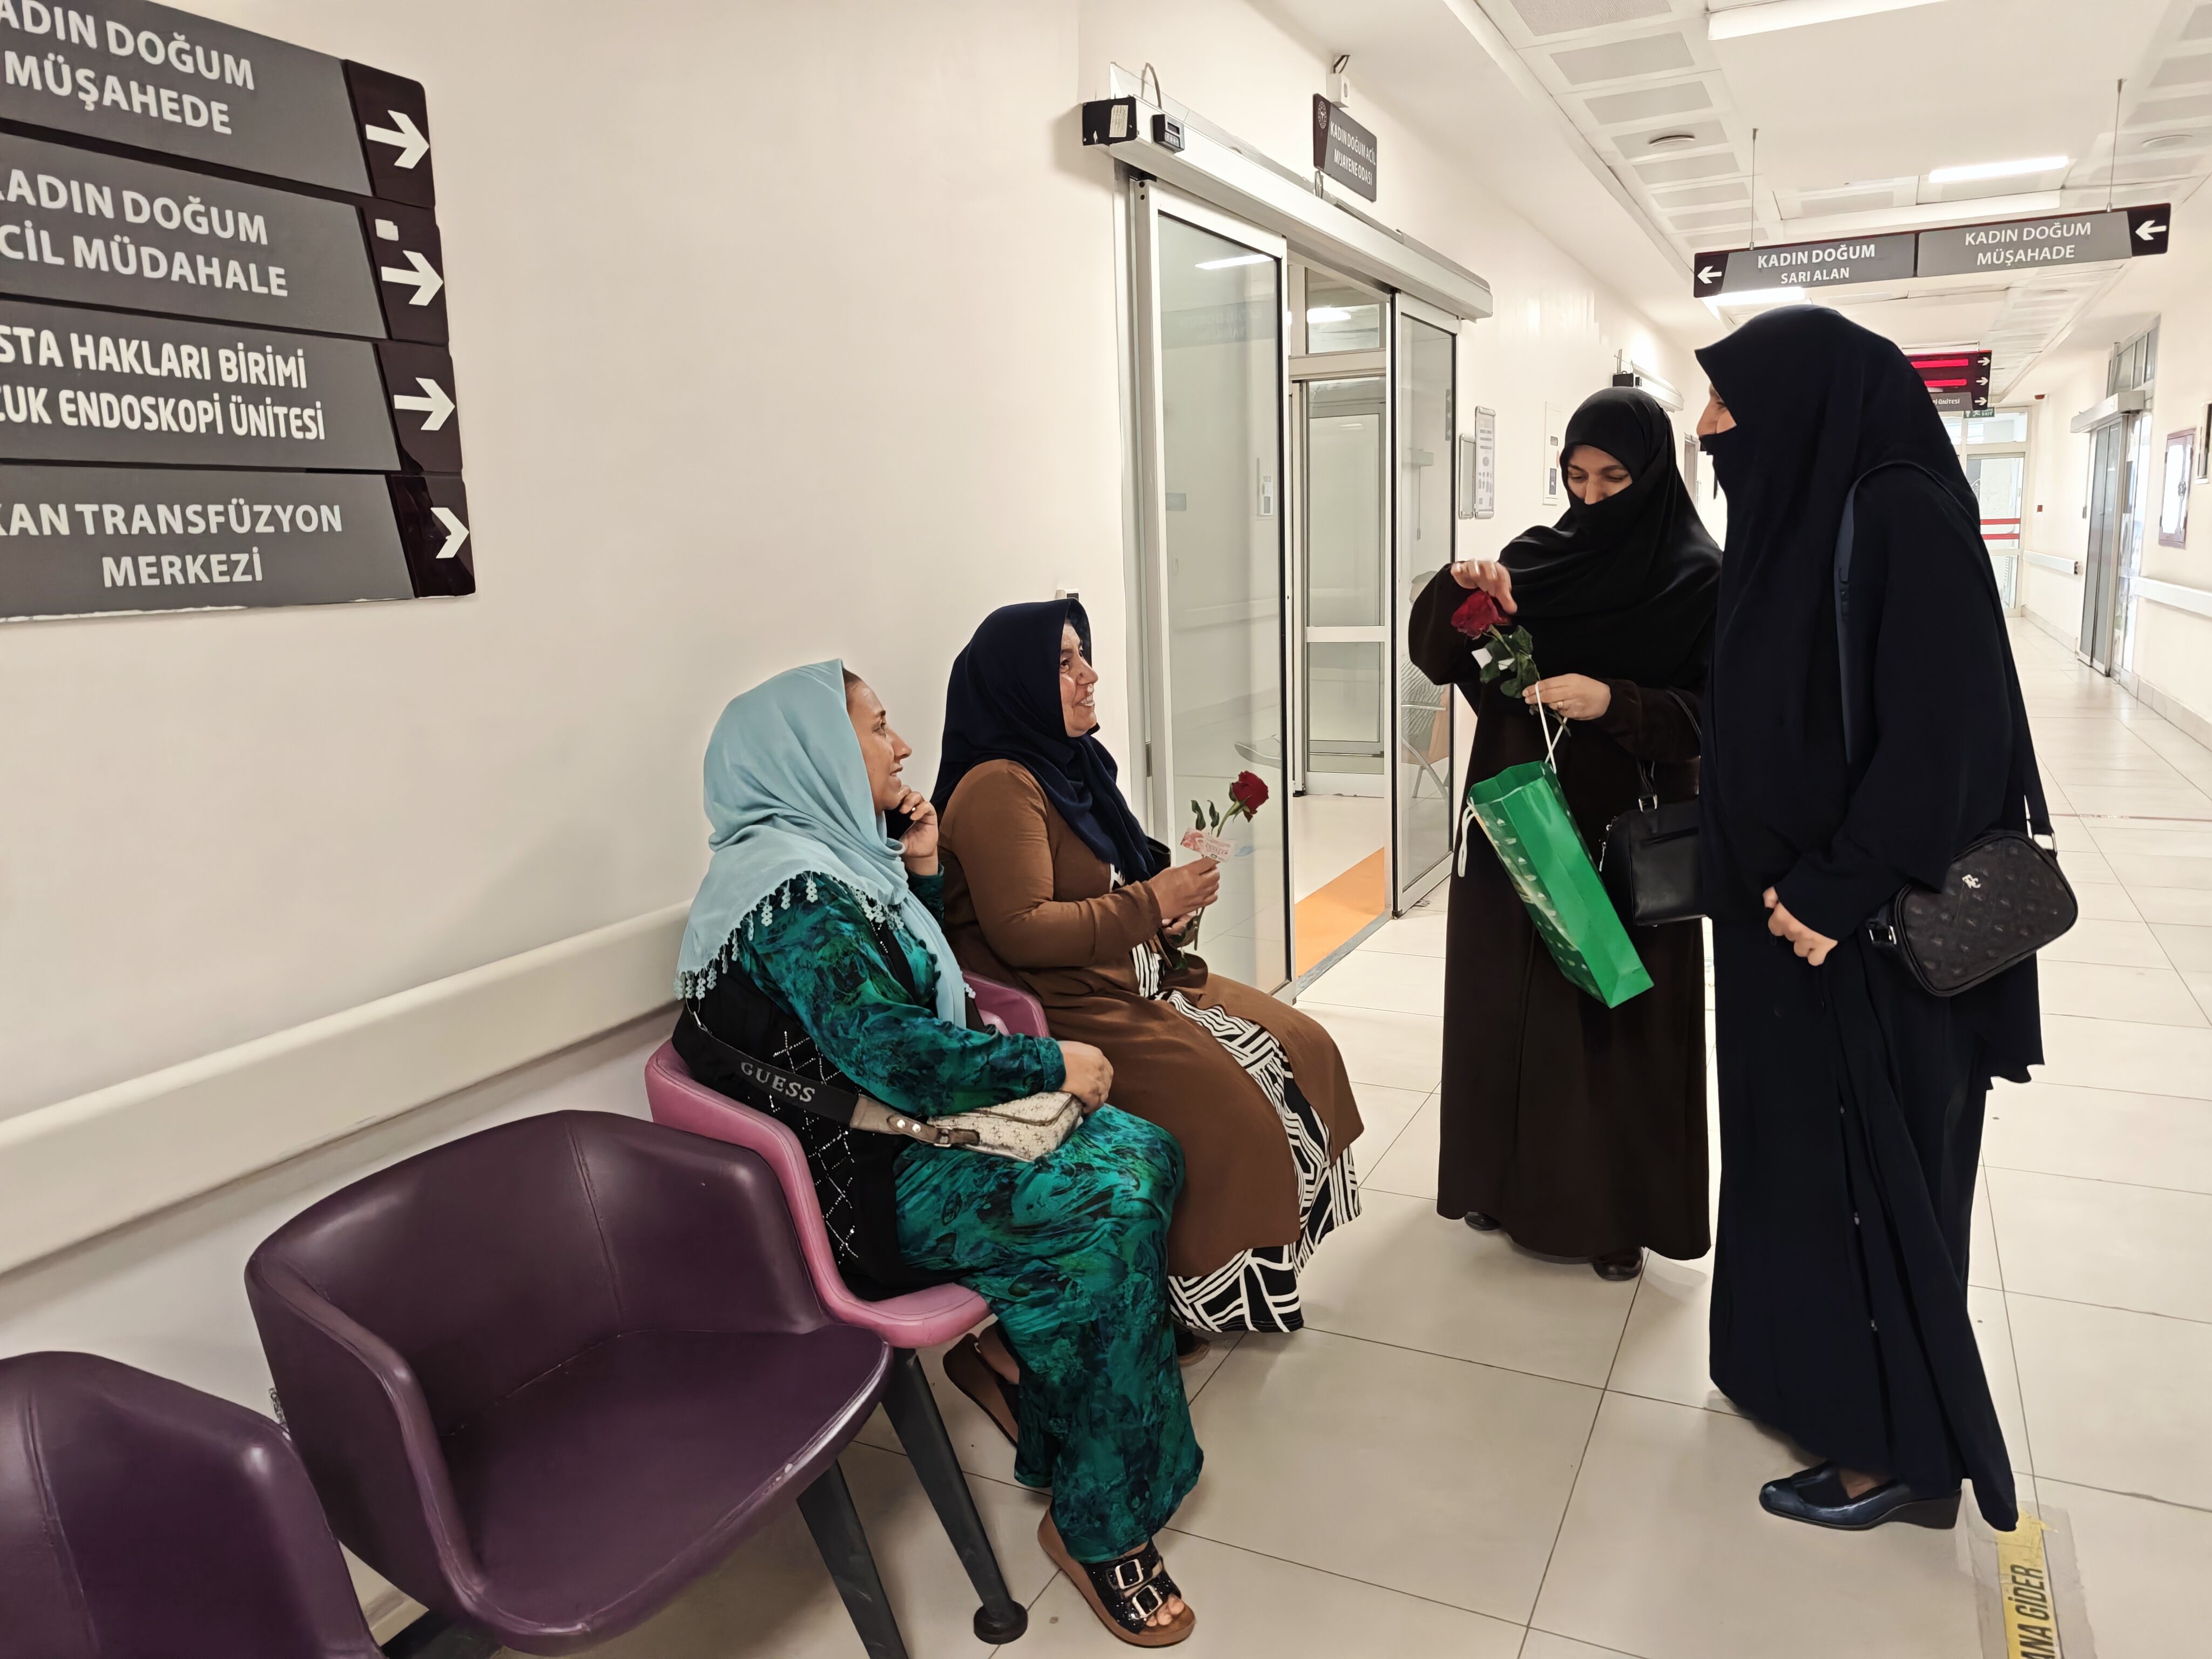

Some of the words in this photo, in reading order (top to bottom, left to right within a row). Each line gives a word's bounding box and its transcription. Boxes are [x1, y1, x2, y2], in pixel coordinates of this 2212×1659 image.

[106, 21, 254, 90] DOĞUM
[4, 50, 232, 134] MÜŞAHEDE
[1330, 122, 1347, 145] KADIN
[1347, 133, 1366, 158] DOĞUM
[1366, 147, 1377, 165] ACİL
[1334, 149, 1358, 177] MUAYENE
[1358, 164, 1372, 186] ODASI
[0, 169, 114, 219] ADIN
[122, 190, 268, 245] DOĞUM
[1965, 228, 2018, 246] KADIN
[2022, 222, 2091, 241] DOĞUM
[0, 220, 65, 265] CİL
[73, 234, 288, 296] MÜDAHALE
[1757, 251, 1808, 268] KADIN
[1812, 244, 1875, 263] DOĞUM
[1781, 271, 1810, 284] SARI
[1813, 267, 1850, 281] ALAN
[1977, 245, 2075, 266] MÜŞAHADE
[0, 325, 64, 367] STA
[70, 333, 211, 380] HAKLARI
[218, 342, 307, 388] BİRİMİ
[0, 384, 52, 425] UK
[58, 389, 224, 434] ENDOSKOPİ
[229, 395, 325, 440] ÜNİTESİ
[75, 498, 342, 535] TRANSFÜZYON
[102, 547, 262, 588] MERKEZİ
[741, 1062, 815, 1102] GUESS
[2008, 1564, 2050, 1621] GİDER
